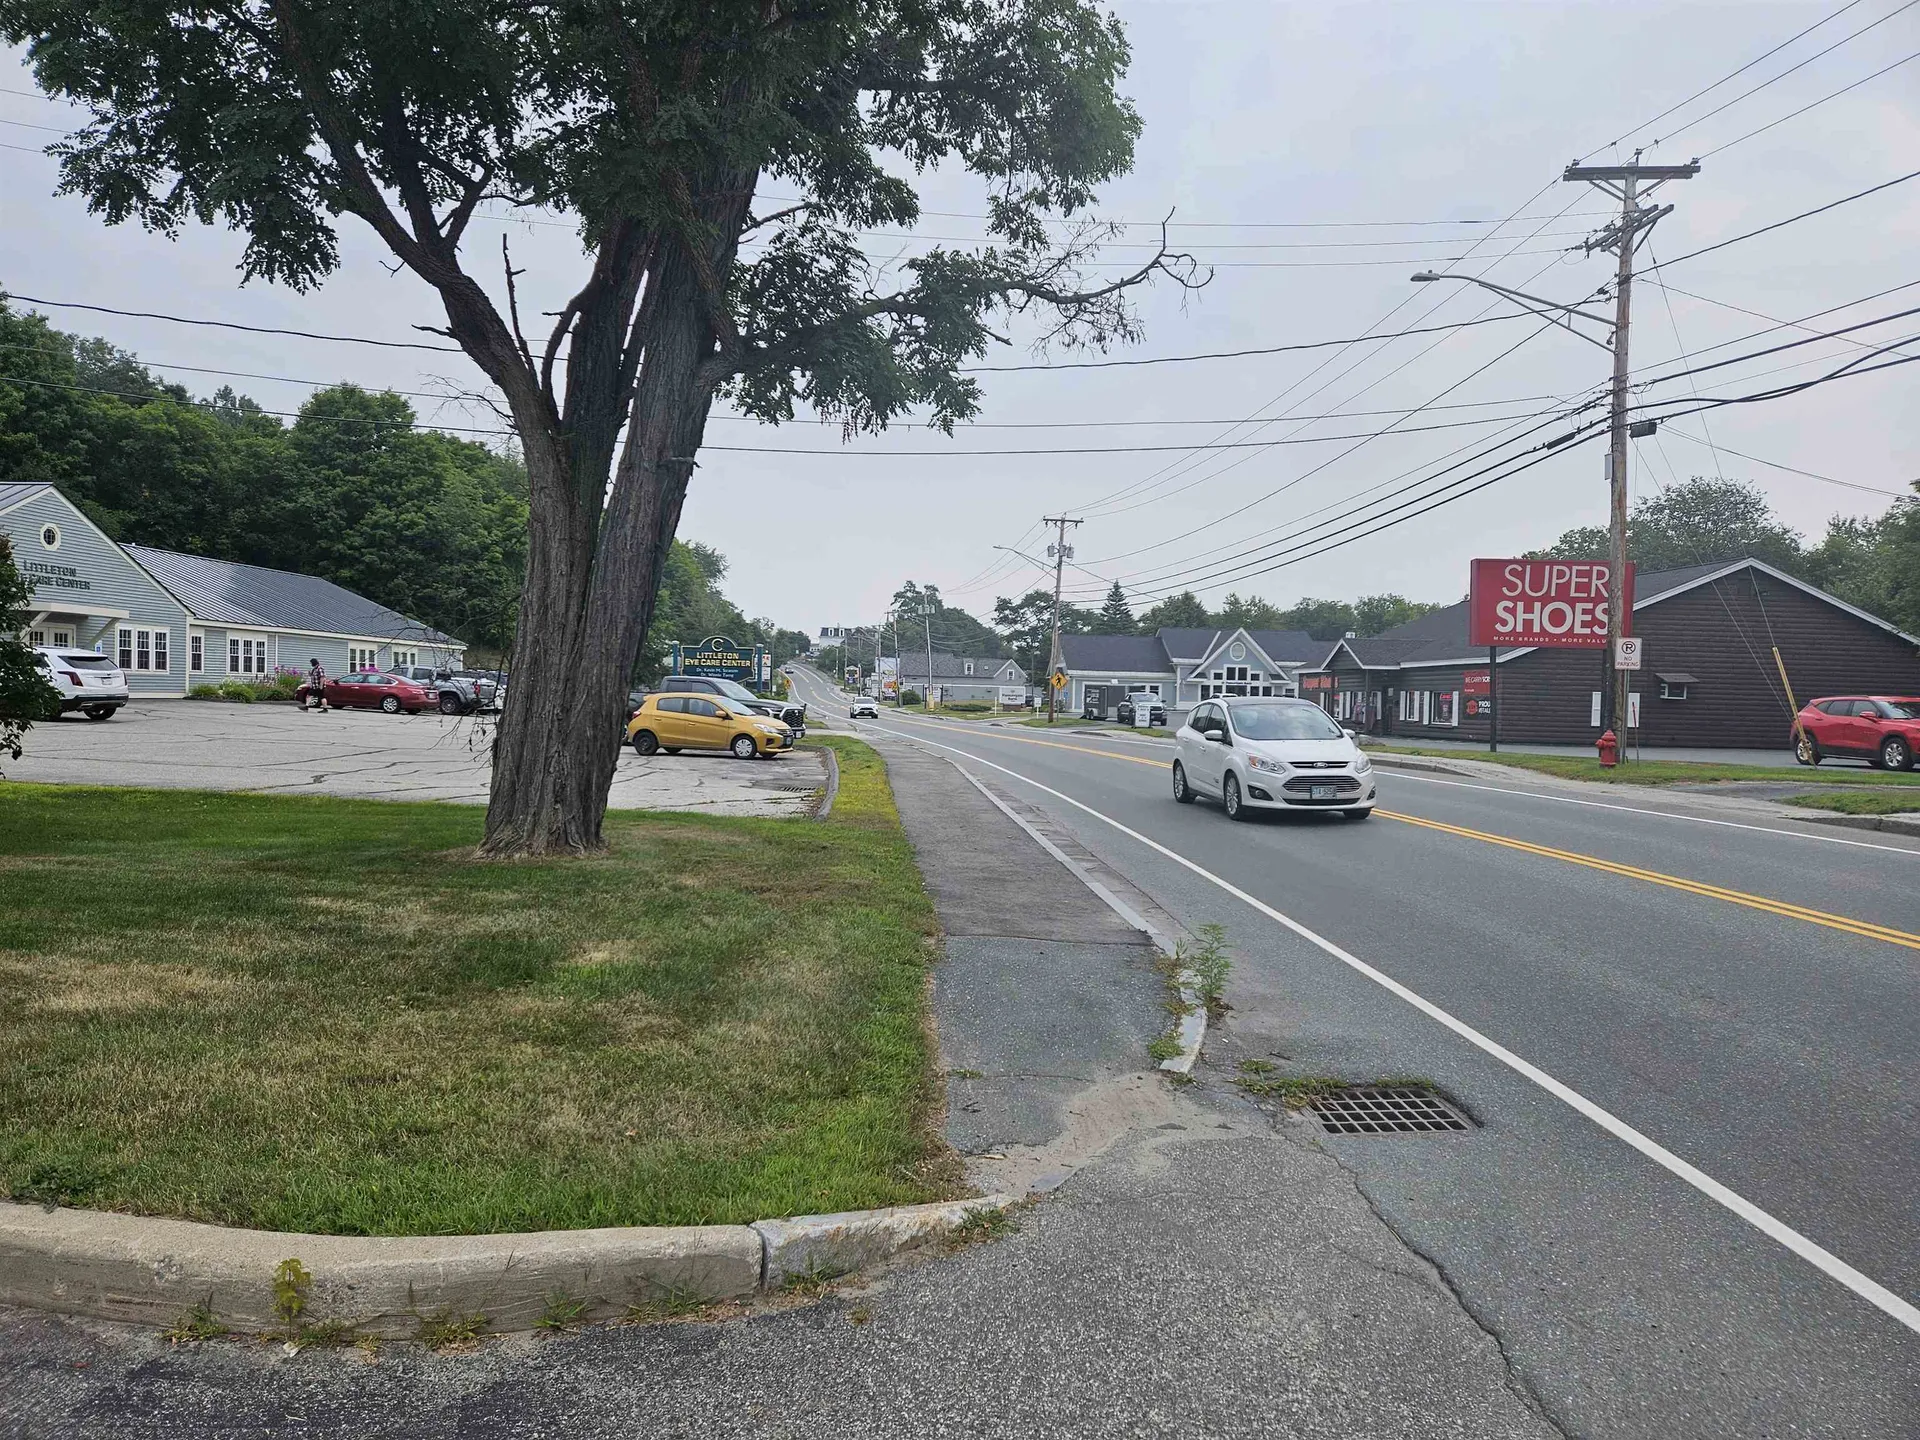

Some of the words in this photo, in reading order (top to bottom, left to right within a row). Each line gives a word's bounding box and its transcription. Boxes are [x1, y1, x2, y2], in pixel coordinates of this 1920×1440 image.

[23, 560, 77, 577] LITTLETON
[1502, 564, 1610, 598] SUPER
[55, 577, 91, 590] CENTER
[1495, 601, 1608, 635] SHOES
